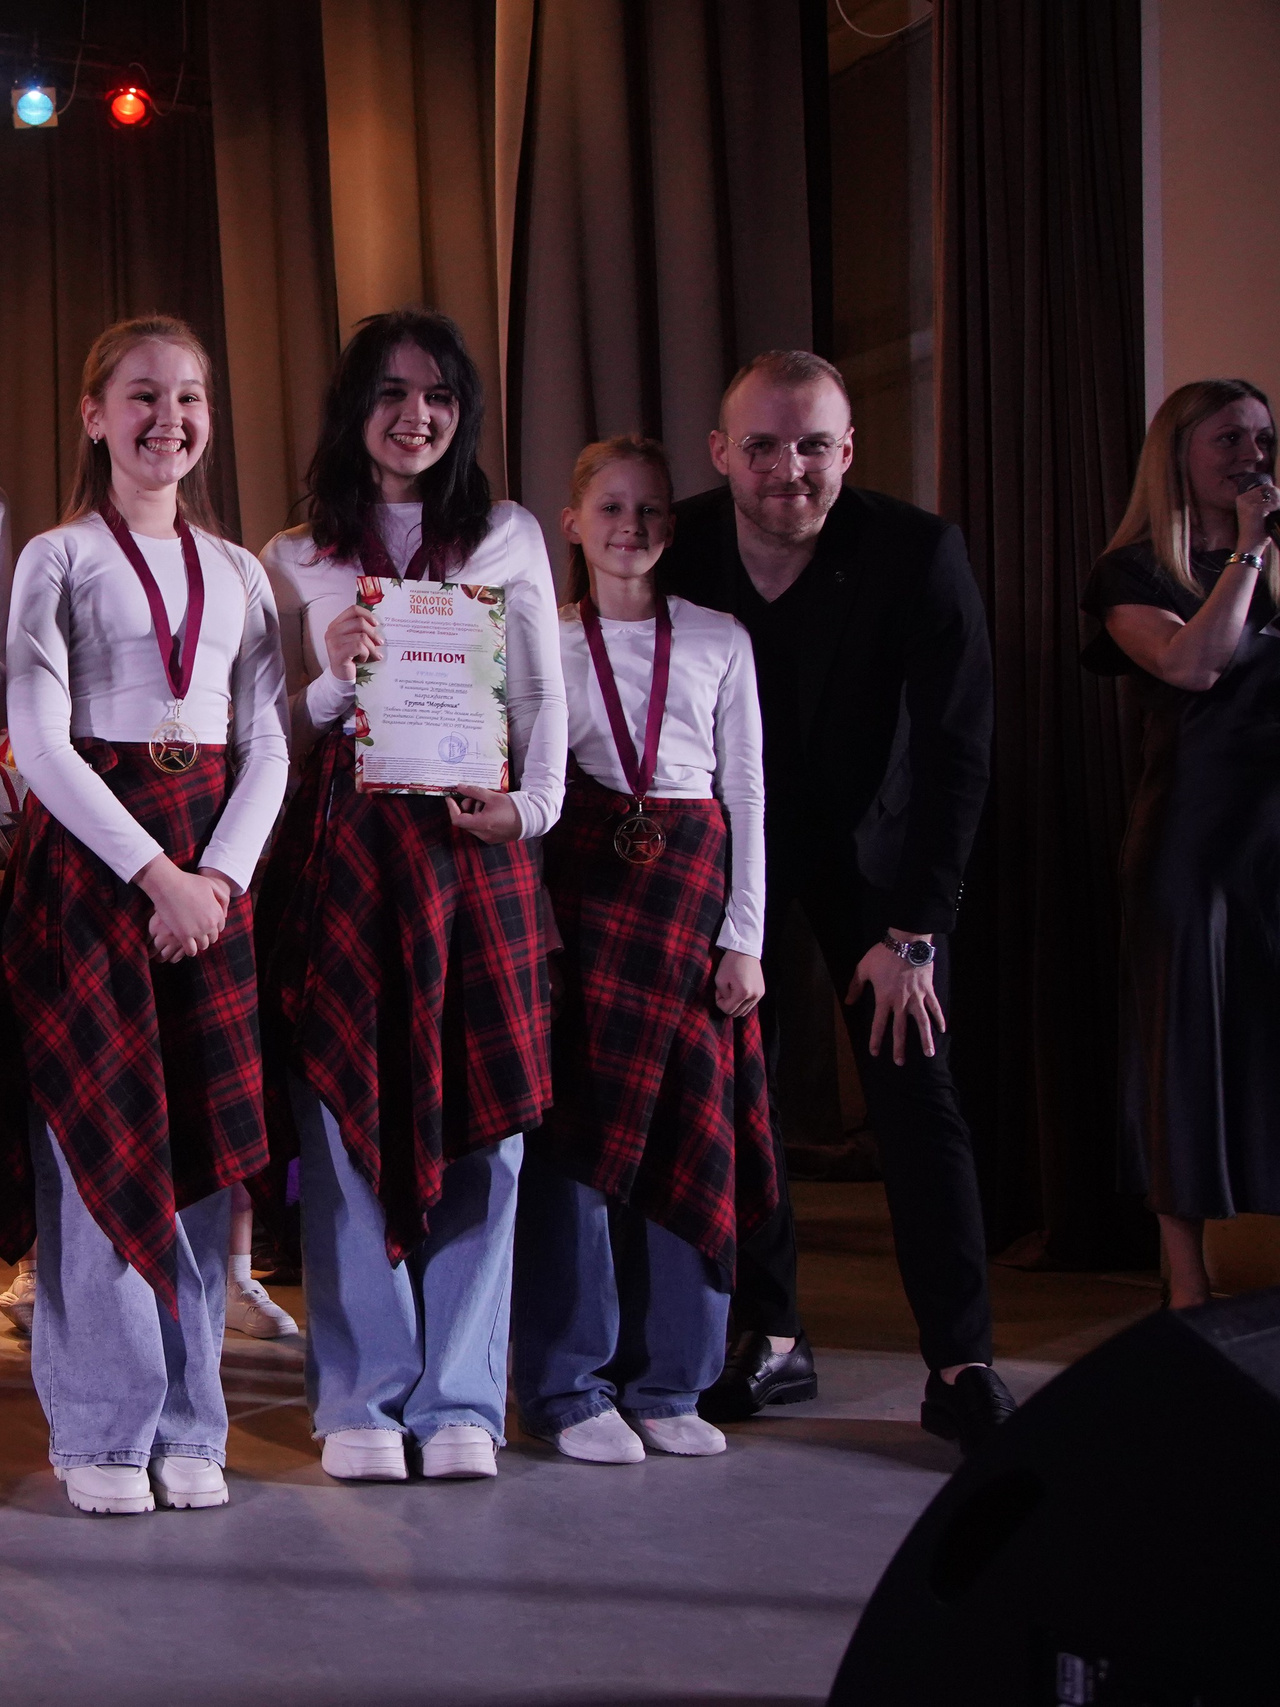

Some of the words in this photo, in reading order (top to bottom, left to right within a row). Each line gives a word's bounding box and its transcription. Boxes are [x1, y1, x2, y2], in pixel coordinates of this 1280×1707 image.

[409, 594, 453, 606] ЗОЛОТОЕ
[409, 605, 453, 616] ЯБЛОЧКО
[400, 651, 465, 664] ДИПЛОМ
